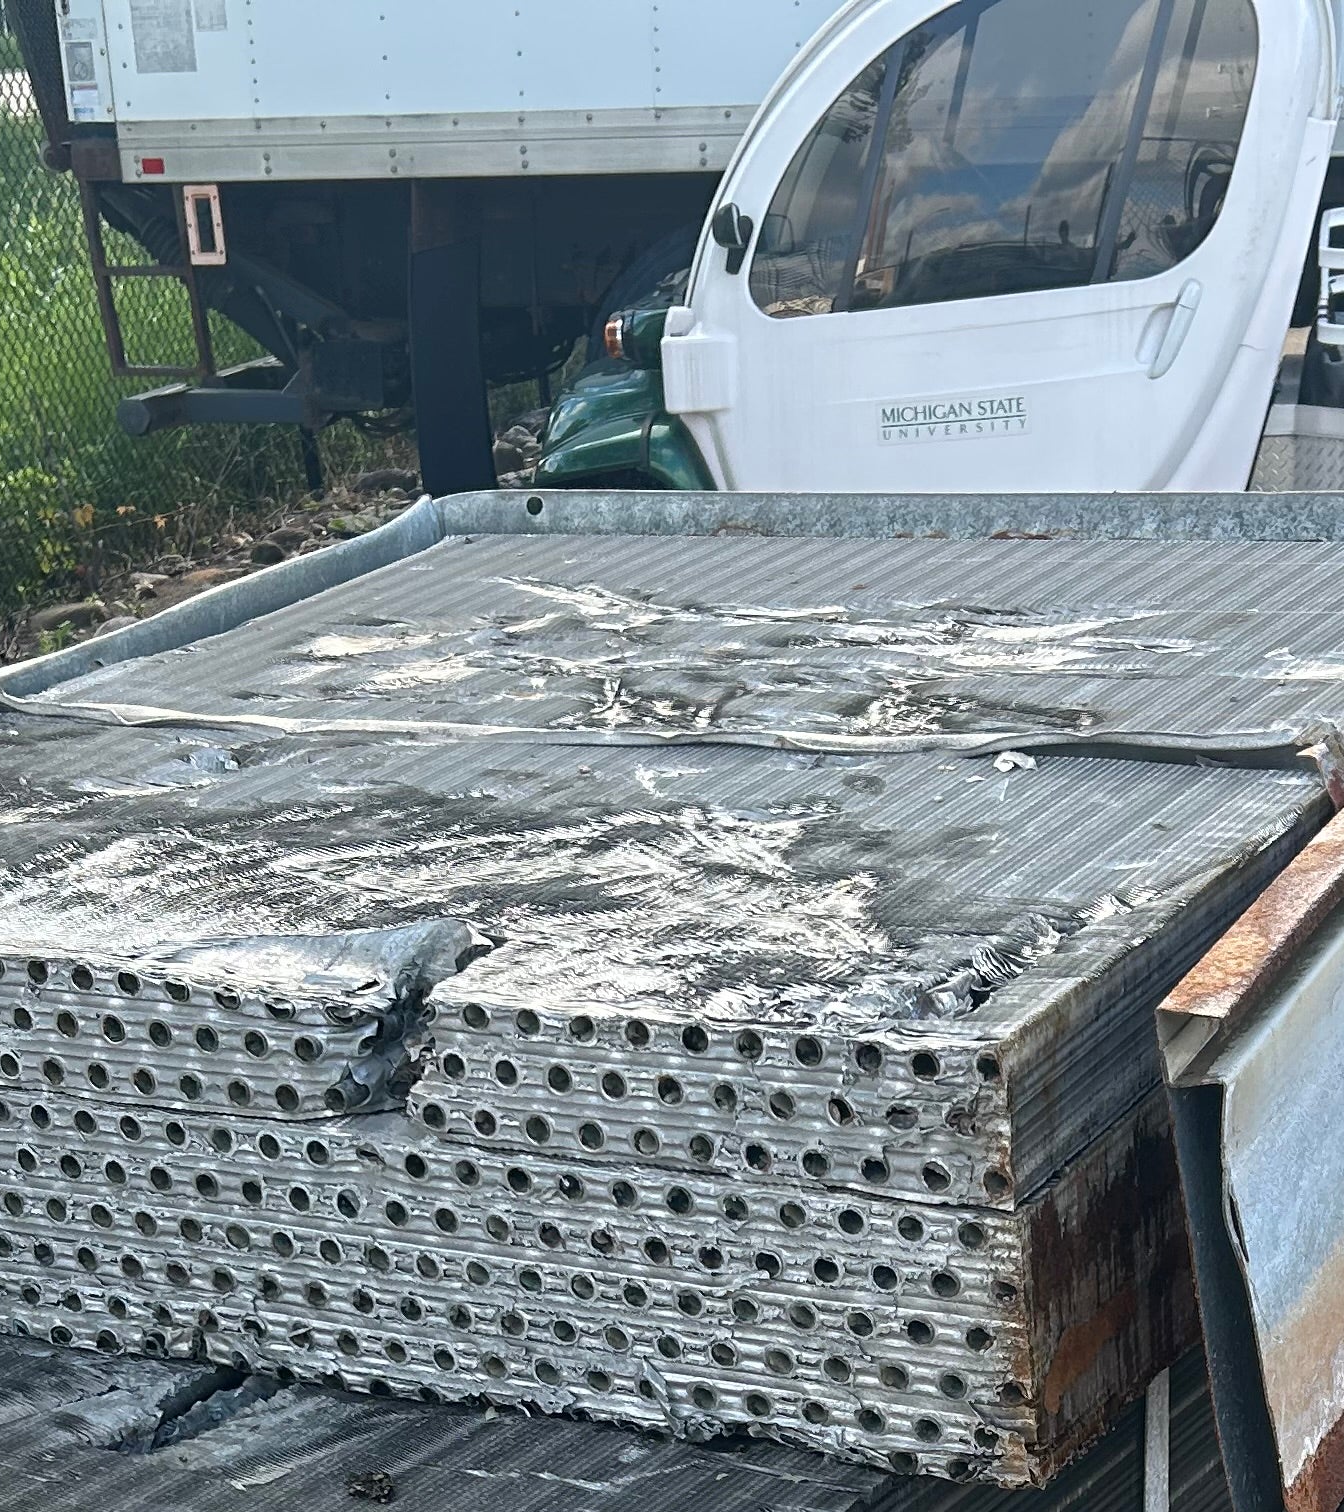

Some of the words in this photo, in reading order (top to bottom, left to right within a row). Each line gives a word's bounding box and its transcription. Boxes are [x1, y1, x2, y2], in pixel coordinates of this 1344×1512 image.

[881, 401, 972, 423] MICHIGAN
[977, 396, 1026, 416] STATE
[882, 418, 1026, 440] UNIVERSITY
